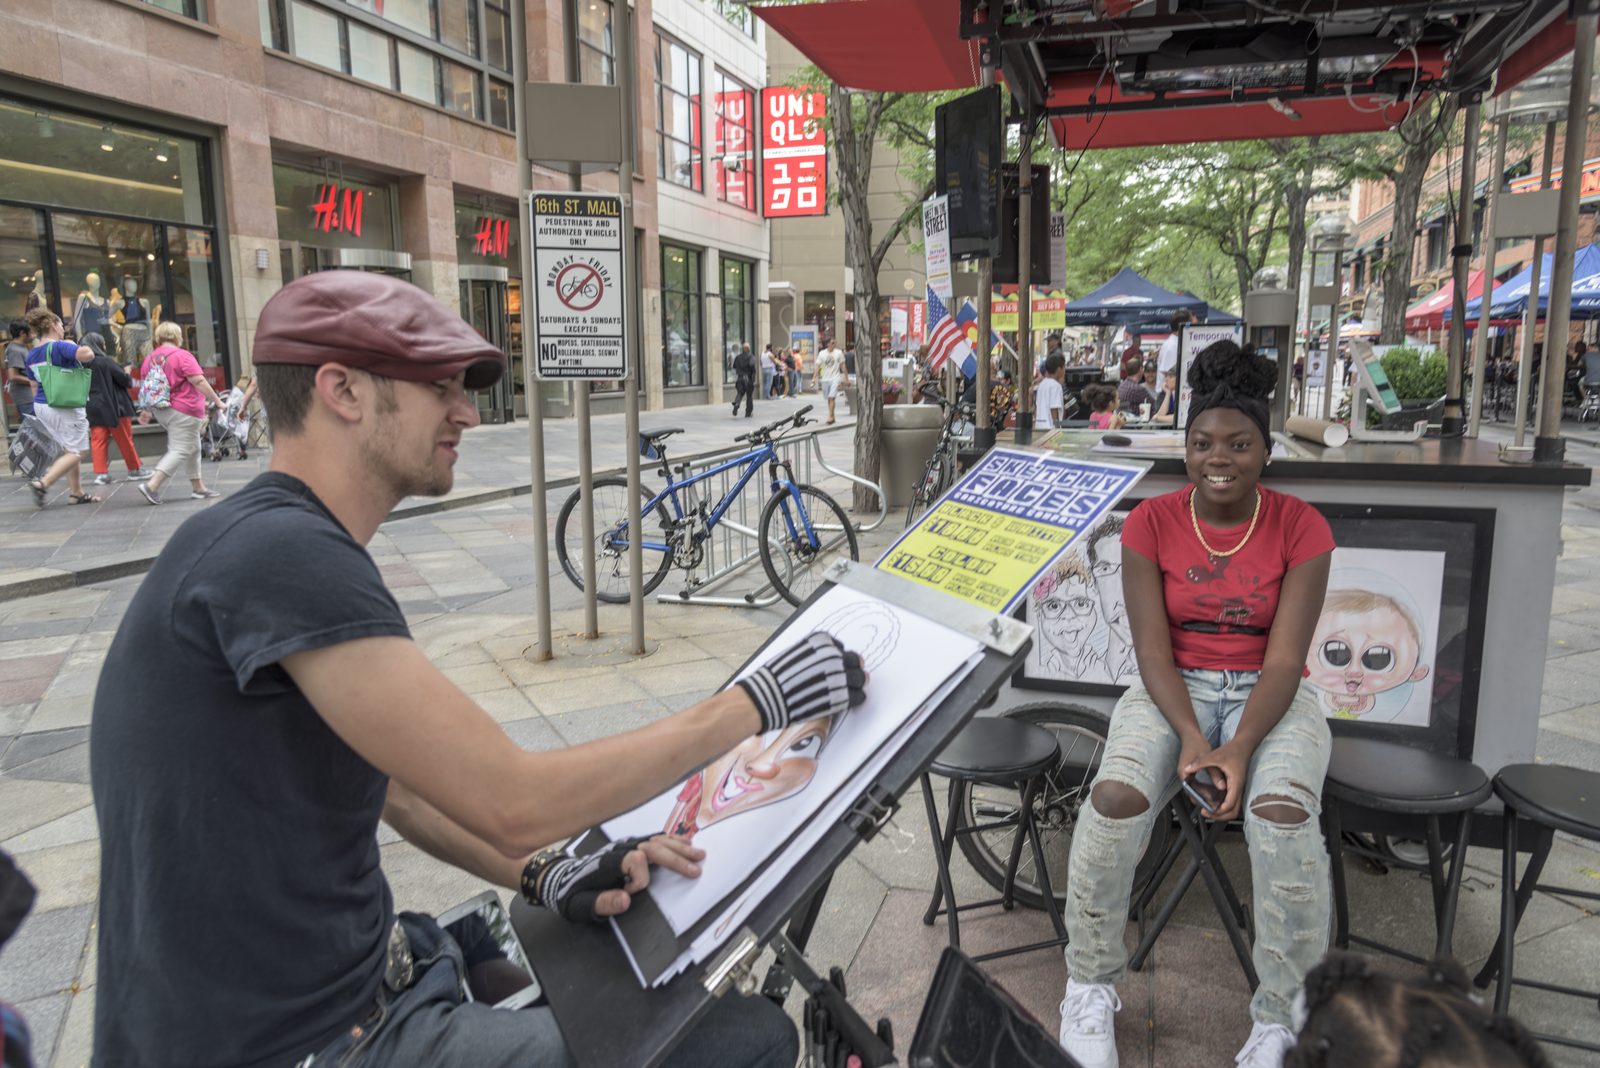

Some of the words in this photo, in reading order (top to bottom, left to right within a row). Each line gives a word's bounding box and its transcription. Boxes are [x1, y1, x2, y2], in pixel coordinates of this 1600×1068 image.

[770, 94, 813, 118] UNI
[770, 119, 818, 146] QLO
[311, 183, 364, 237] H&M
[535, 197, 560, 214] 16th
[564, 199, 582, 215] ST.
[587, 199, 619, 216] MALL
[539, 227, 582, 236] AUTHORIZED
[585, 229, 617, 237] VEHICLES
[545, 218, 592, 227] PEDESTRIANS
[595, 220, 610, 228] AND
[925, 212, 947, 237] STREET
[472, 215, 510, 258] H&M
[569, 238, 587, 246] ONLY
[547, 254, 574, 287] MONDAY
[589, 257, 613, 288] FRIDAY
[540, 316, 580, 324] SATURDAYS
[582, 316, 587, 324] &
[590, 316, 621, 325] SUNDAYS
[564, 325, 598, 333] EXCEPTED
[1188, 331, 1233, 341] Temporary
[541, 343, 558, 361] NO
[558, 358, 582, 366] ANYTIME
[598, 349, 619, 357] SEGWAY
[560, 368, 586, 376] ORDINANCE
[982, 455, 1127, 493] SKETCHY
[961, 472, 1109, 518] FACES
[954, 492, 1023, 514] CARICATURE
[1026, 510, 1086, 527] COMPANY
[938, 503, 992, 525] BLACK
[1005, 519, 1071, 543] WHITE
[928, 545, 997, 576] COLOR
